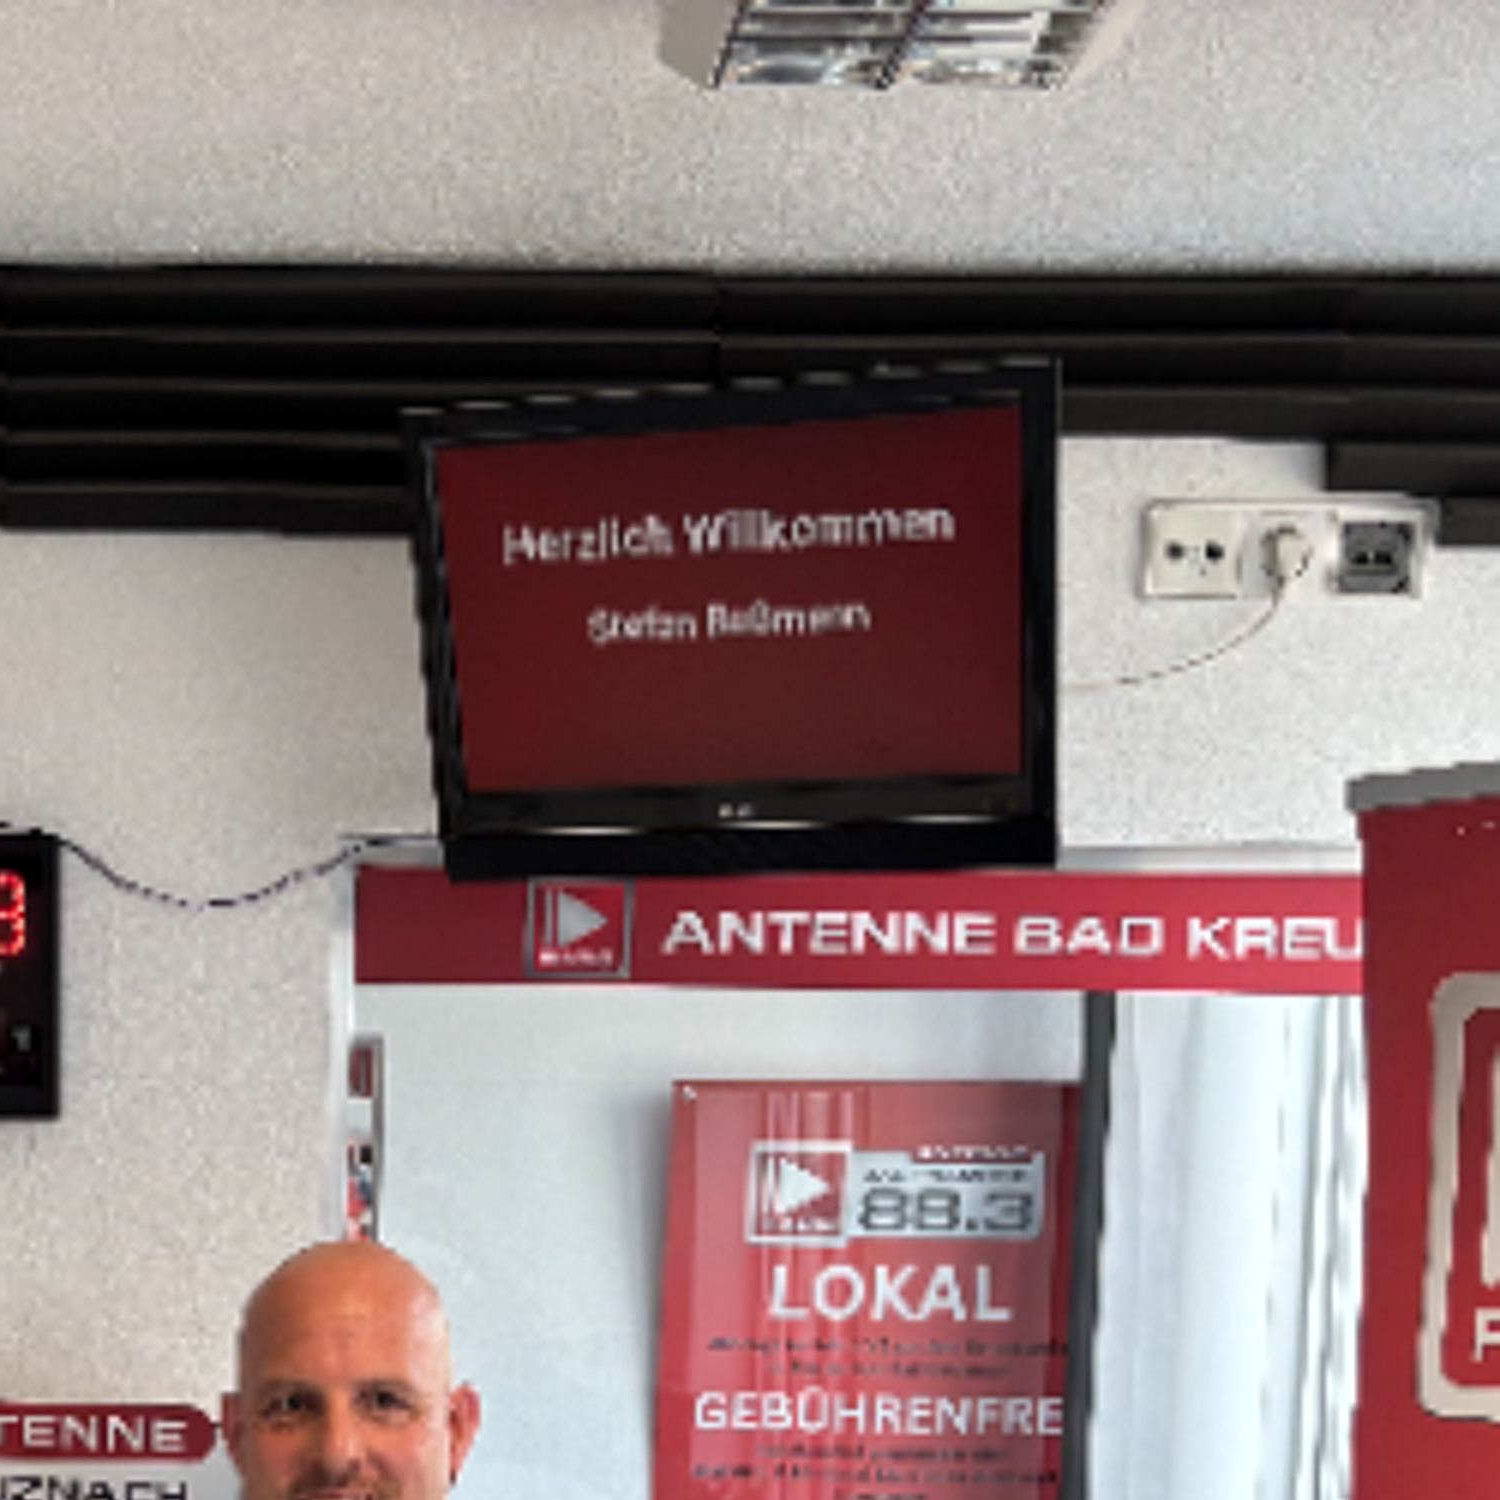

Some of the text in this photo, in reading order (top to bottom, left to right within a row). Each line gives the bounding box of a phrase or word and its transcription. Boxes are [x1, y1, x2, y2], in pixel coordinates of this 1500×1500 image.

[503, 508, 956, 566] Herzlich Willkommen
[660, 910, 997, 954] ANTENNE
[1014, 915, 1165, 956] BAD
[857, 1187, 1034, 1231] 88.3
[767, 1264, 1012, 1321] LOKAL
